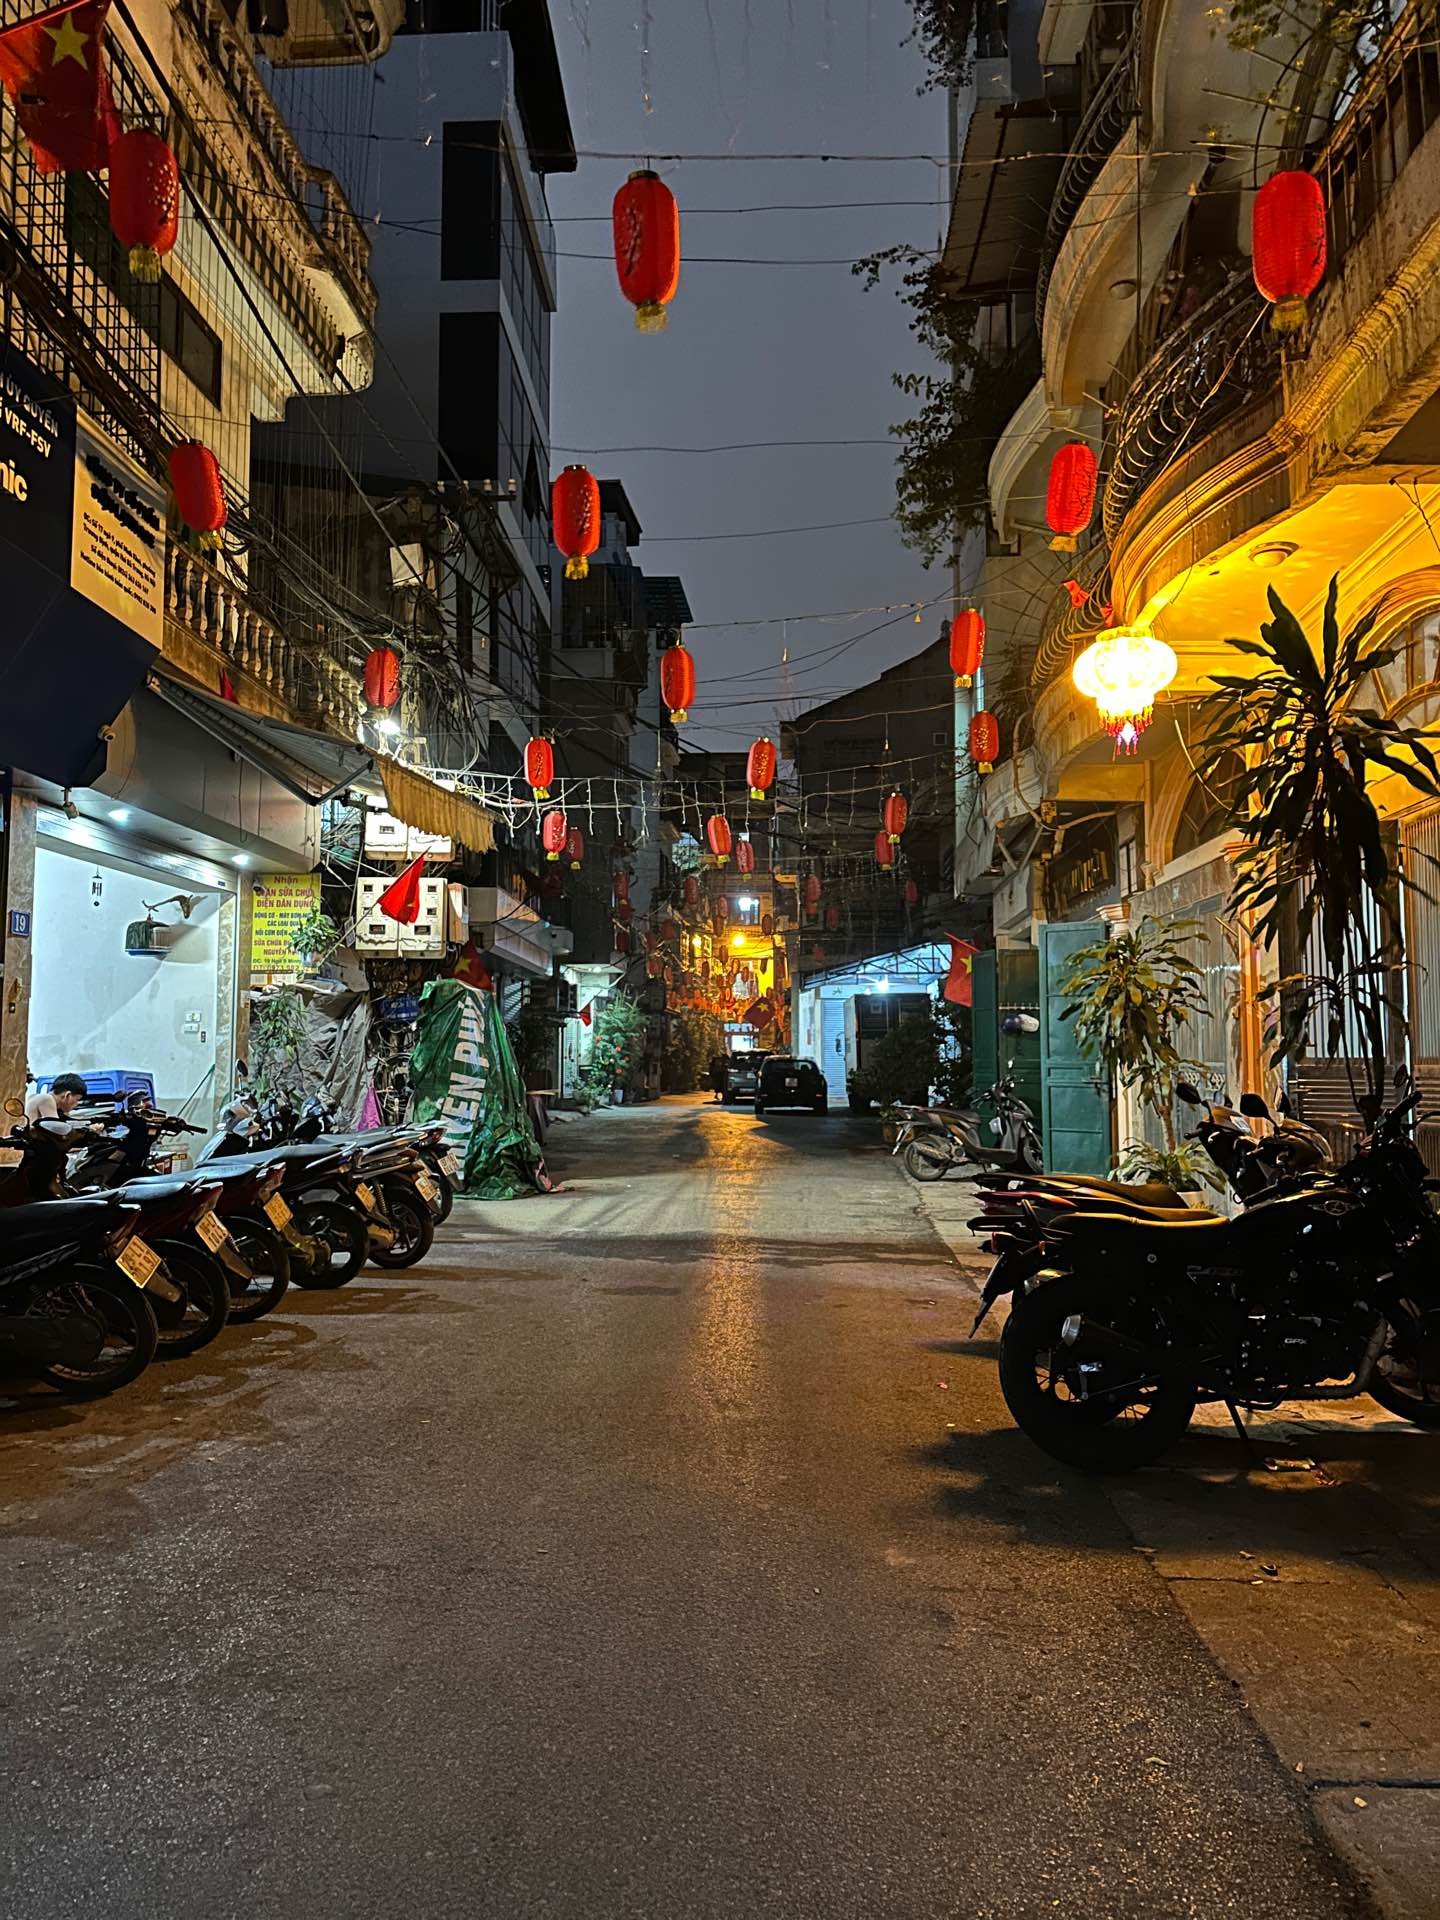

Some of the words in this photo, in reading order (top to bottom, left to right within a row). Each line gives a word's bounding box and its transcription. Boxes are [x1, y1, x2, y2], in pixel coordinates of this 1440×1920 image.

[5, 406, 51, 459] VRF-FSV
[274, 875, 298, 885] Nhận
[14, 914, 26, 932] 19
